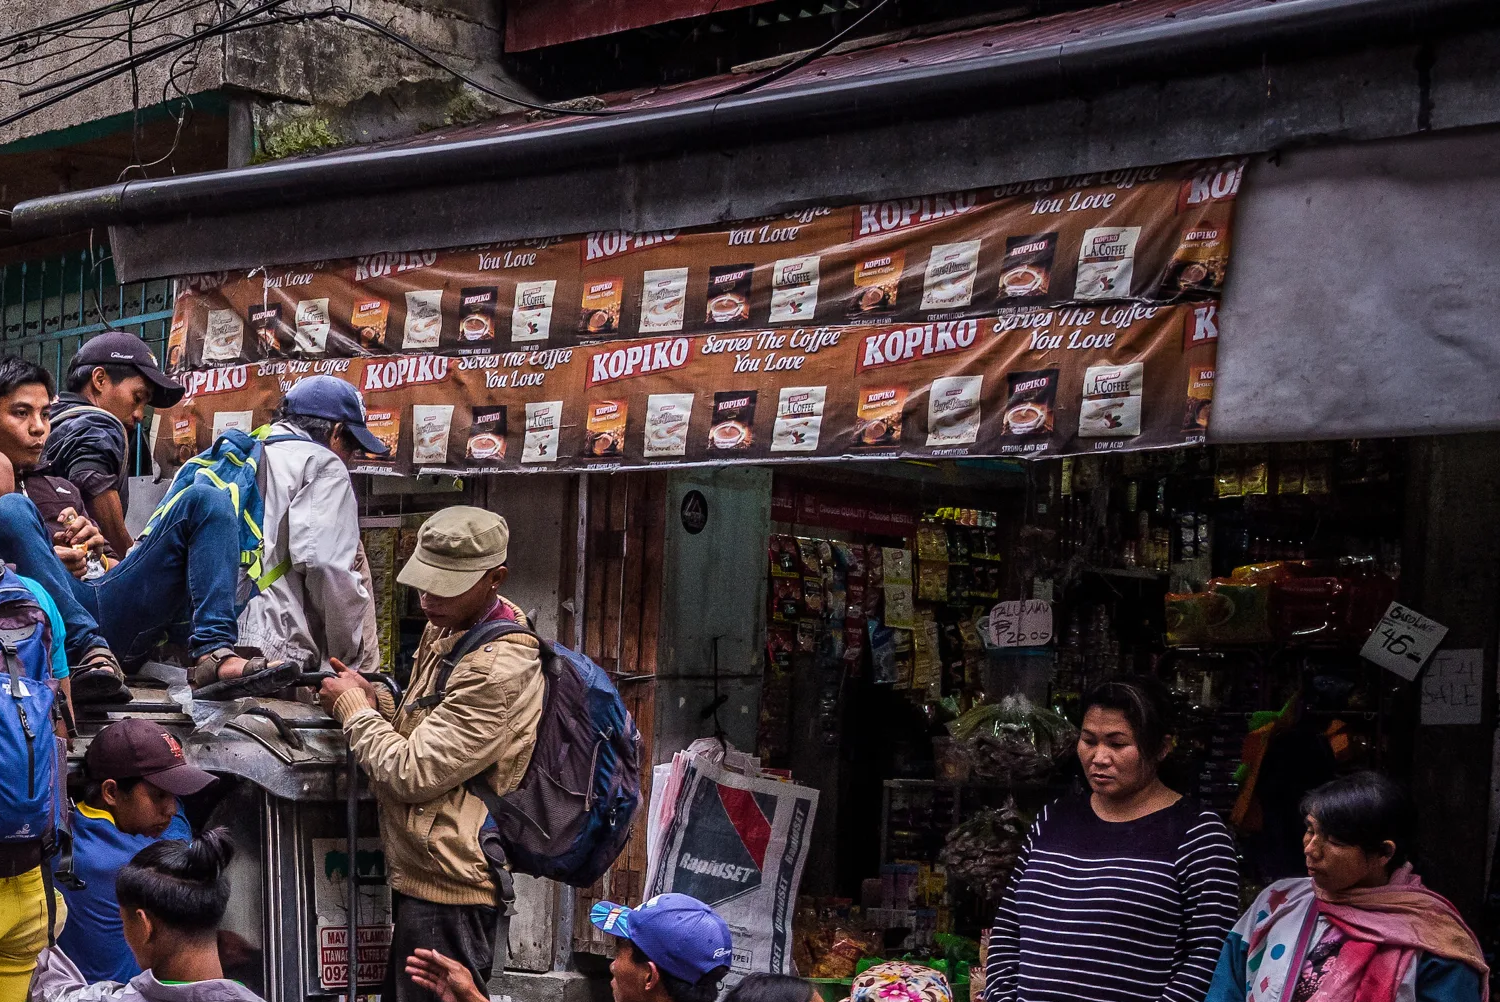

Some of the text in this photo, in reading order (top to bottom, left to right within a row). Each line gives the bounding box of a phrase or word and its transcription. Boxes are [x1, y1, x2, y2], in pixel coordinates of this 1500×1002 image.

[1031, 191, 1116, 215] You Love
[728, 225, 799, 246] You Love
[1012, 242, 1046, 256] KOPIKO
[478, 250, 537, 271] You Love
[864, 257, 892, 269] KOPIKO
[284, 271, 314, 287] Love
[714, 271, 744, 284] KOPIKO
[590, 282, 613, 294] KOPIKO
[464, 292, 491, 304] KOPIKO
[992, 302, 1157, 333] Serves The Coffee
[702, 328, 841, 355] Serves The Coffee
[862, 318, 978, 367] KOPIKO
[1029, 328, 1116, 350] You Love
[313, 359, 350, 375] Coffee
[502, 353, 524, 367] The
[529, 349, 573, 370] Coffee
[591, 337, 690, 383] KOPIKO
[733, 352, 806, 373] You Love
[364, 355, 449, 391] KOPIKO
[485, 369, 545, 389] You Love
[1015, 378, 1046, 393] KOPIKO
[718, 398, 748, 410] KOPIKO
[868, 390, 896, 403] KOPIKO
[368, 412, 391, 422] KOPIKO
[595, 404, 618, 415] KOPIKO
[477, 412, 501, 425] KOPIKO
[1035, 443, 1048, 451] RICH
[1094, 441, 1124, 450] LOW ACID
[841, 507, 867, 519] QUALITY
[679, 851, 753, 884] RapidSET
[327, 931, 347, 945] MAY
[732, 953, 746, 963] YPE
